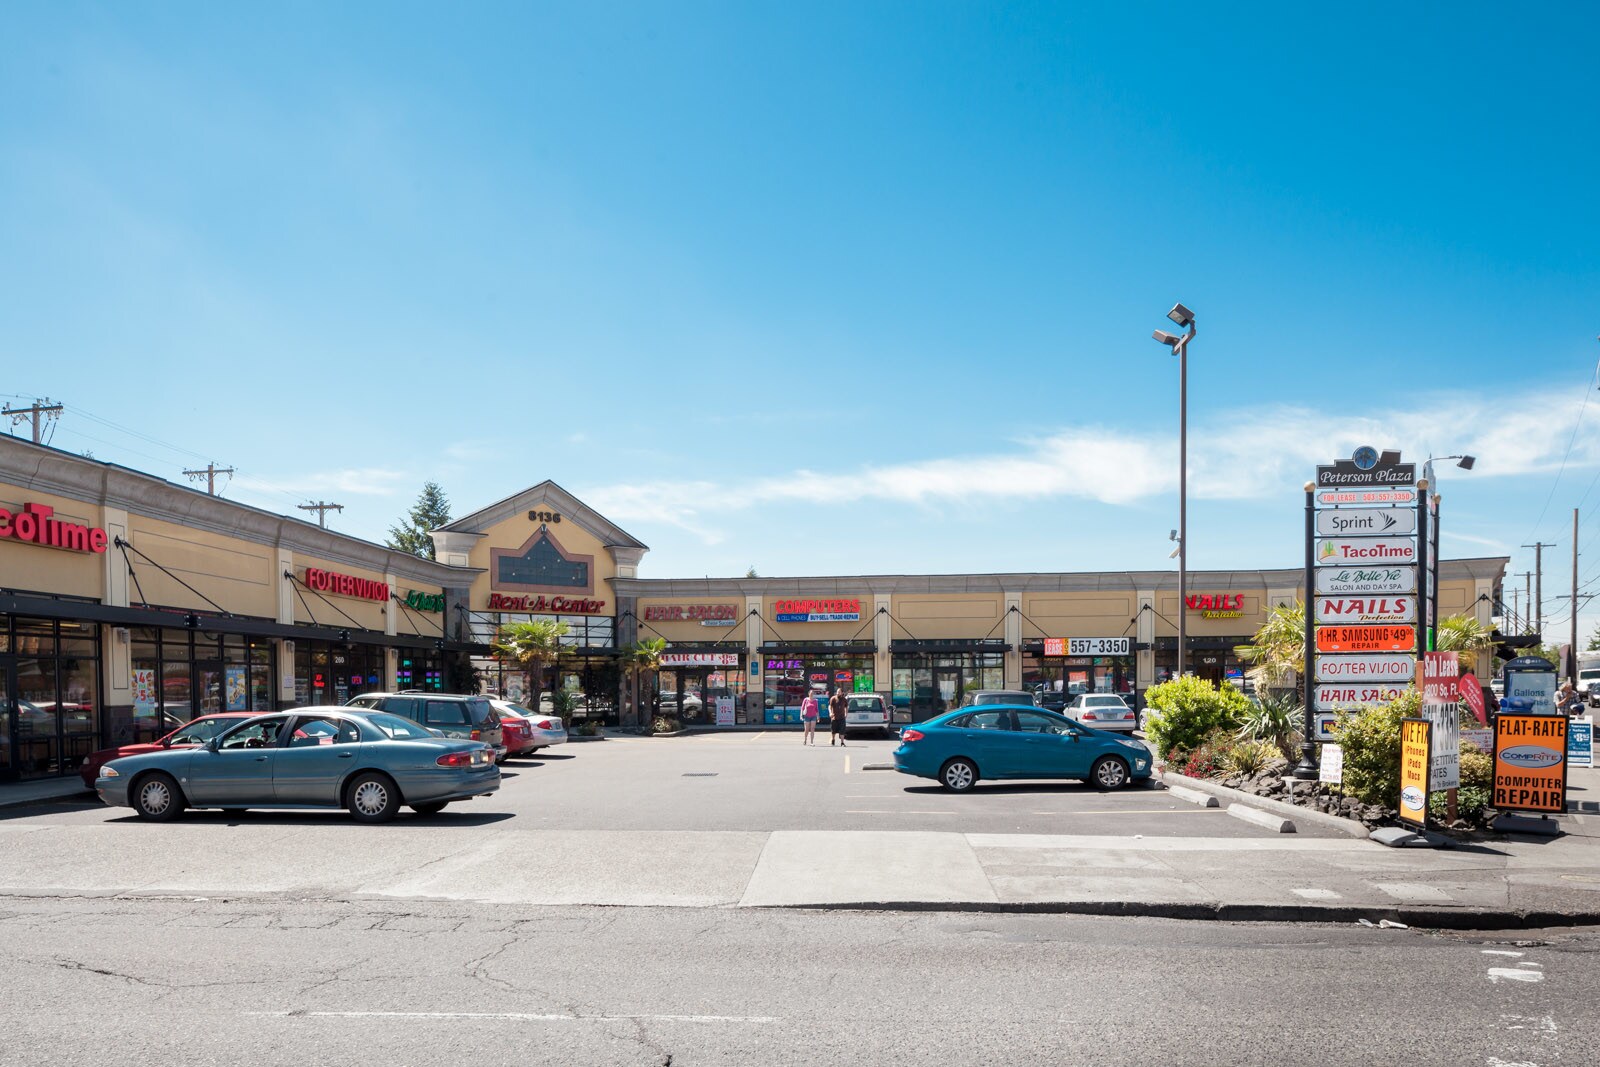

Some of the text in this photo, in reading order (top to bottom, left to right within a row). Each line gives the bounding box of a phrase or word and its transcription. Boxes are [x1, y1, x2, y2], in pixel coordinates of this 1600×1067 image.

[1320, 469, 1412, 483] Peterson Plaza
[1362, 493, 1410, 501] 503-557-3350
[528, 510, 561, 523] 8136
[1332, 516, 1373, 531] Sprint
[1341, 545, 1412, 558] TacoTime
[1330, 569, 1401, 582] La Belle Vie
[306, 567, 389, 602] FOSTER VISION
[775, 599, 861, 614] COMPUTERS
[1185, 593, 1245, 610] NAILS
[1323, 599, 1407, 614] NAILS
[644, 605, 738, 620] HAIR SALON
[1341, 628, 1389, 642] SAMSUNG
[1045, 643, 1063, 655] LEASE
[1070, 639, 1128, 653] 557-3350
[1321, 662, 1408, 675] FOSTER VISION
[1424, 654, 1459, 678] Sub Lease
[138, 671, 146, 683] 4
[1320, 689, 1357, 702] HAIR
[1514, 688, 1545, 697] Gallons
[1402, 721, 1414, 742] WE
[1499, 719, 1564, 737] FLAT-RATE
[1431, 767, 1447, 779] ATES
[1497, 775, 1562, 789] COMPUTER
[1496, 788, 1561, 807] REPAIR
